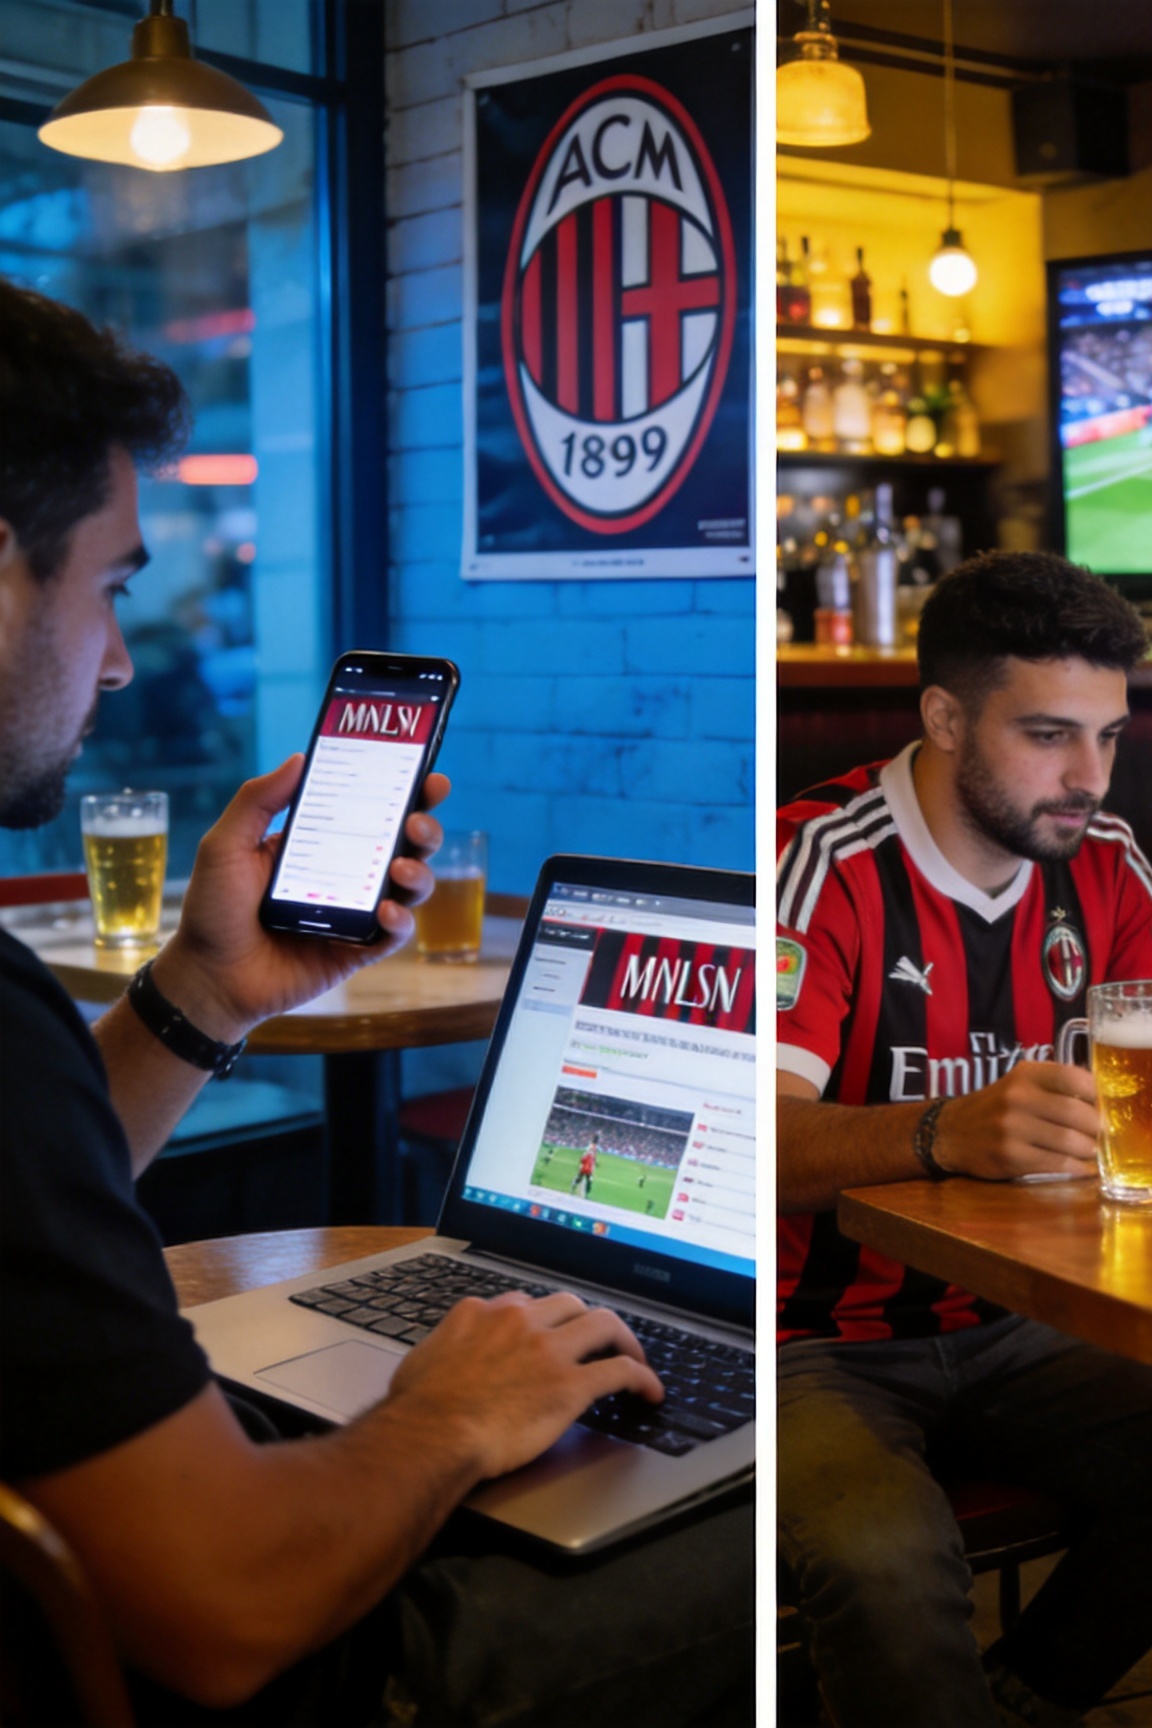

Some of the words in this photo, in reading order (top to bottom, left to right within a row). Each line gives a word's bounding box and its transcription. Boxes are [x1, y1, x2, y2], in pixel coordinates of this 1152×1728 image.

[547, 113, 685, 217] ACM
[561, 425, 668, 479] 1899
[620, 954, 742, 1014] MNLSN
